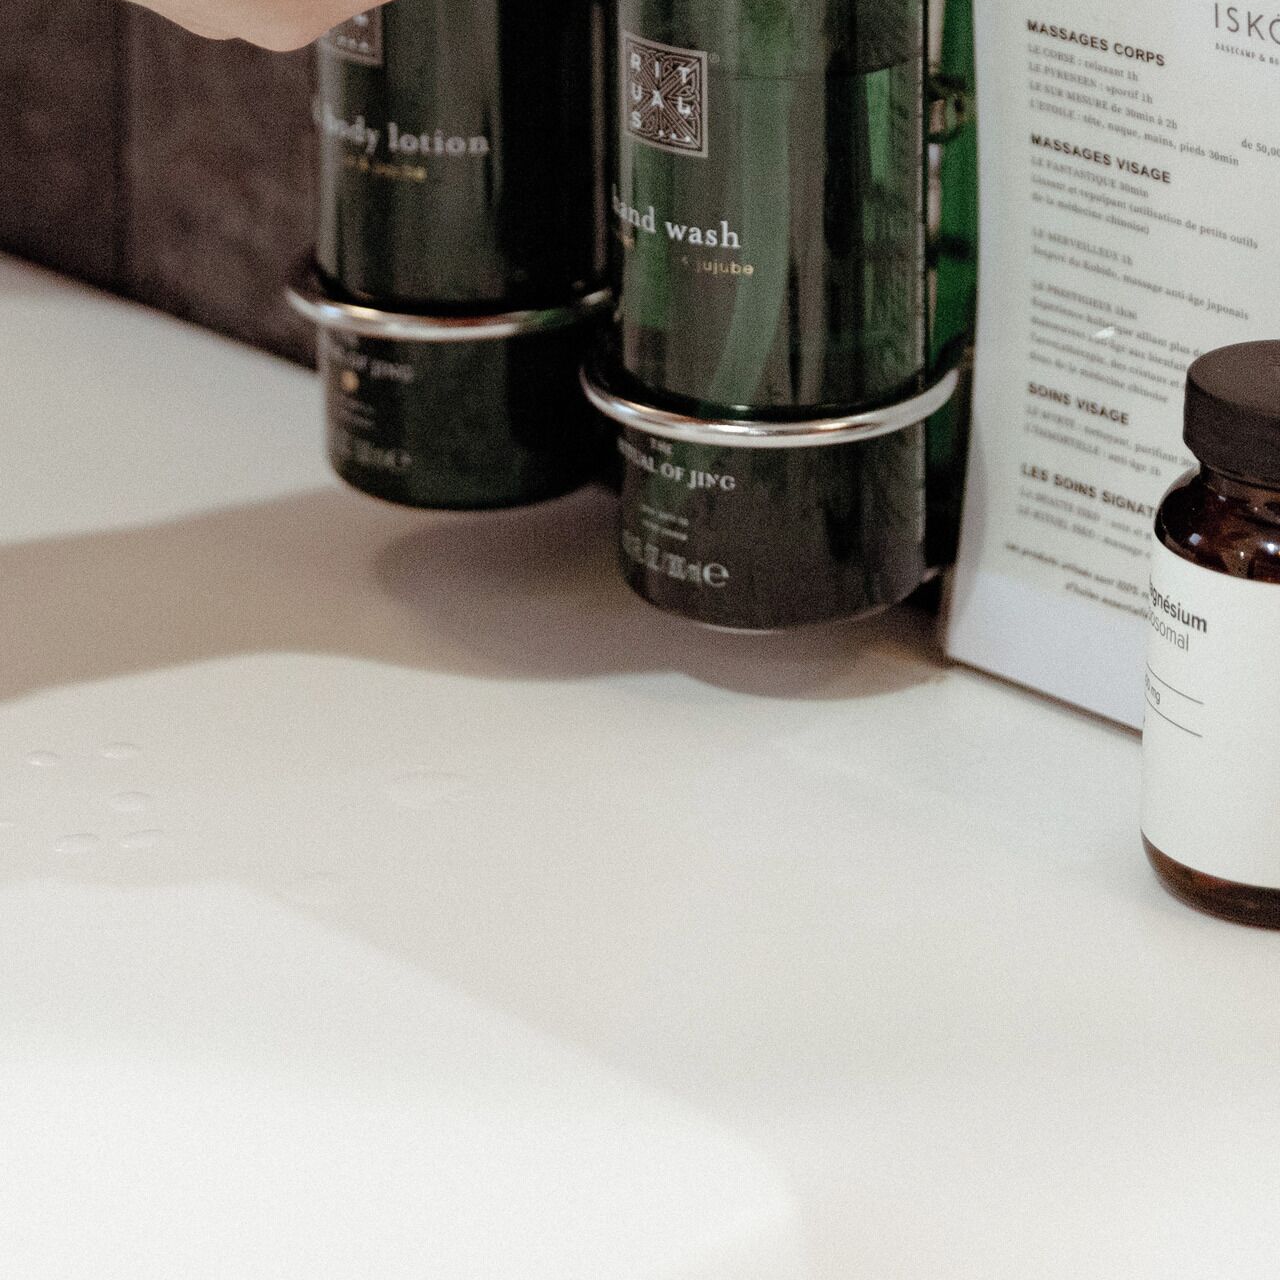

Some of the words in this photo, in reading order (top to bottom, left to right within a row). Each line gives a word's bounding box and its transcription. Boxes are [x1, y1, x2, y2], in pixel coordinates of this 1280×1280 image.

[1026, 19, 1109, 51] MASSAGES
[1113, 42, 1166, 67] CORPS
[388, 121, 491, 157] lotion
[1179, 141, 1206, 157] pieds
[1241, 138, 1253, 150] de
[1030, 132, 1112, 166] MASSAGES
[1116, 156, 1172, 184] VISAGE
[665, 219, 741, 249] wash
[1184, 219, 1197, 231] de
[1027, 380, 1071, 406] SOINS
[1076, 397, 1130, 426] VISAGE
[660, 462, 686, 481] OF
[687, 470, 737, 491] JING
[1021, 462, 1049, 482] LES
[1053, 472, 1098, 499] SOINS
[1149, 574, 1207, 634] gnésium
